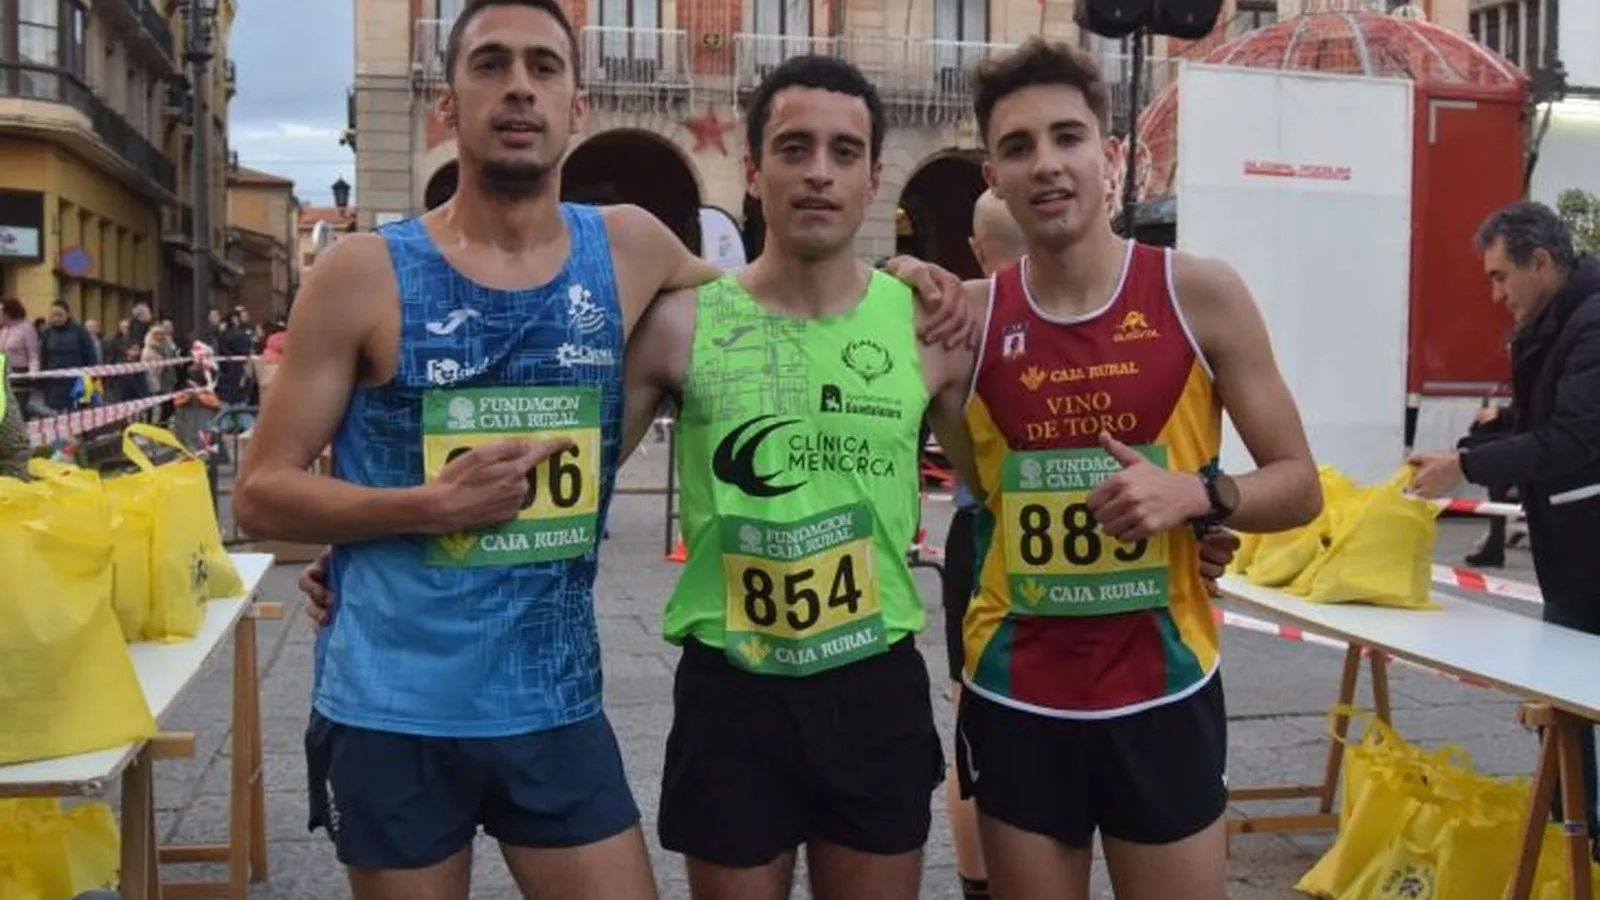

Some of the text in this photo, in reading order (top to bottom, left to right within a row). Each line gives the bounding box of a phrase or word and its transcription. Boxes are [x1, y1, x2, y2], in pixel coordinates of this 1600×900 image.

[1050, 361, 1139, 382] CAJA RURAL
[1046, 391, 1111, 415] VINO
[480, 411, 579, 429] CAJA RURAL
[1027, 412, 1137, 441] DE TORO
[788, 431, 870, 452] CLÍNICA
[788, 453, 896, 477] MENORCA
[480, 527, 589, 551] CAJA RURAL
[806, 527, 854, 551] RURAL
[742, 553, 863, 631] 854
[1050, 579, 1160, 603] CAJA RURAL
[775, 627, 879, 665] CAJA RURAL
